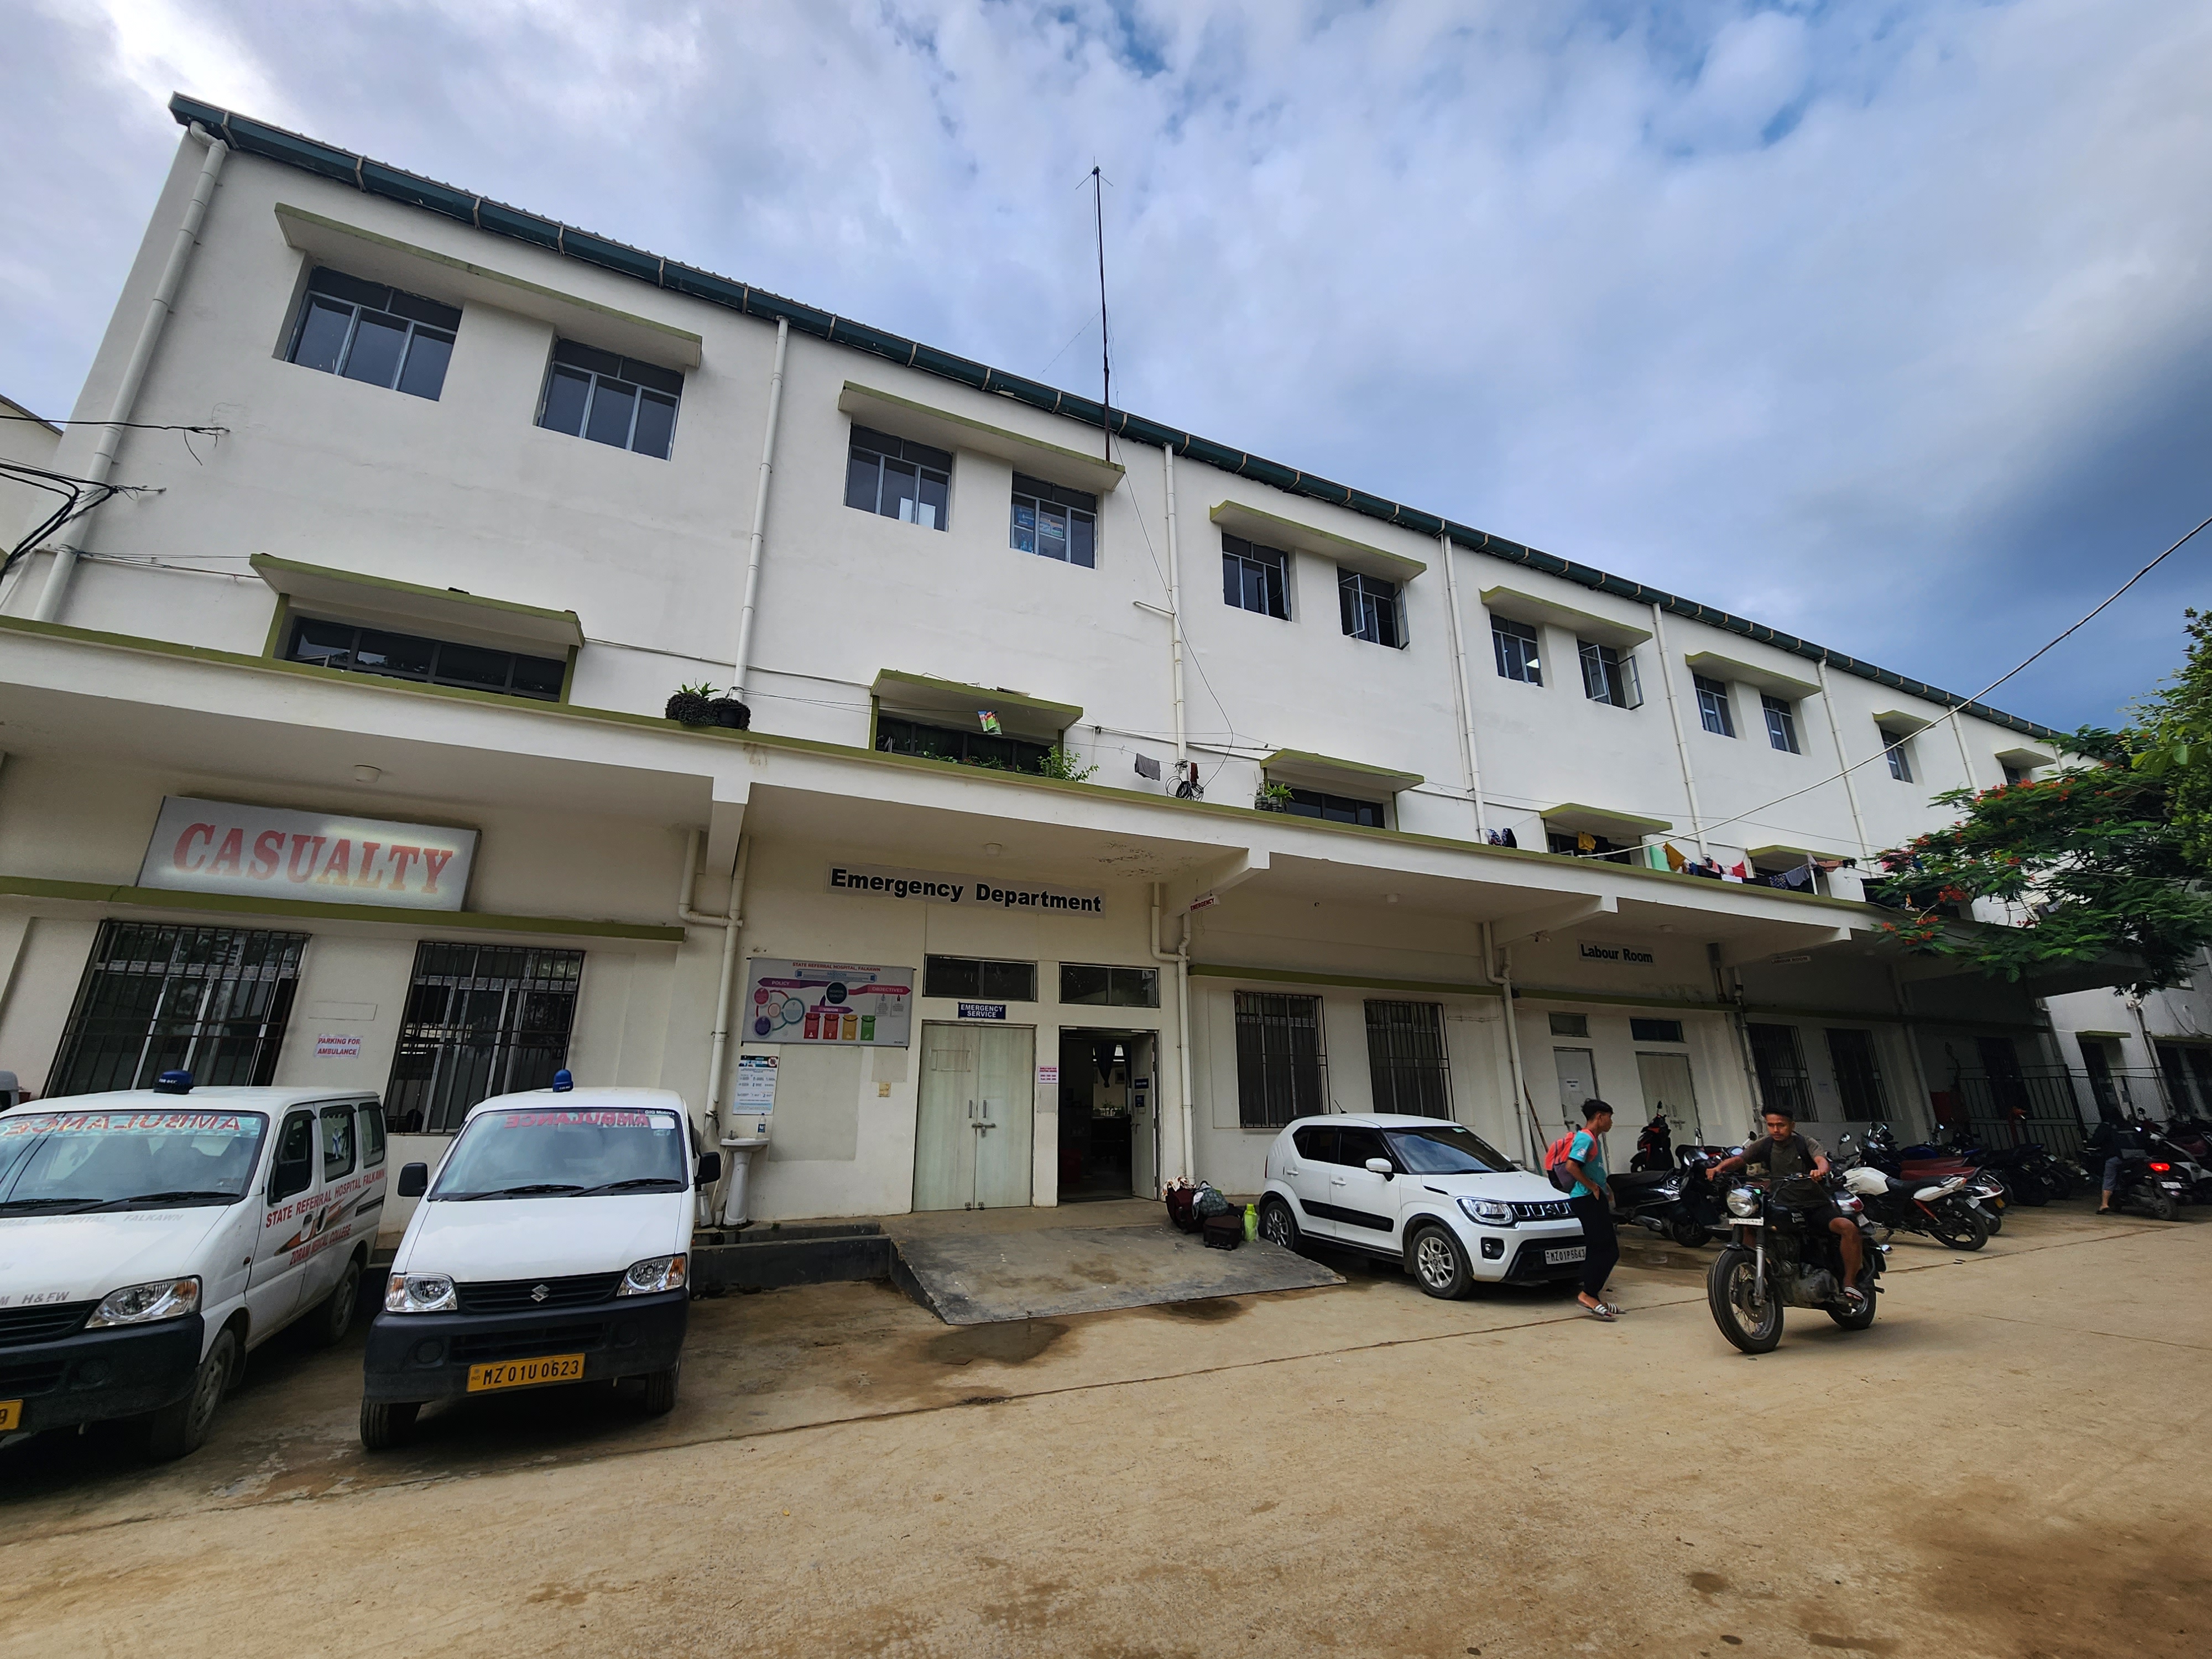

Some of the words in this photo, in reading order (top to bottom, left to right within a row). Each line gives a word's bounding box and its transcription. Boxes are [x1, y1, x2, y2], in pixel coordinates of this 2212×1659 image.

[173, 822, 453, 894] CASUALTY
[831, 868, 964, 902] Emergency
[975, 883, 1102, 912] Department
[1190, 898, 1215, 911] EMERGENCY
[1580, 943, 1619, 960] Labour
[1623, 948, 1653, 963] Room
[961, 1004, 1003, 1013] EMERGENCY
[266, 1204, 293, 1228] STATE
[295, 1190, 332, 1215] REFERRAL
[335, 1178, 361, 1199] HOSPITAL
[43, 1215, 107, 1225] HOSPITAL
[123, 1214, 185, 1222] FALKAWN
